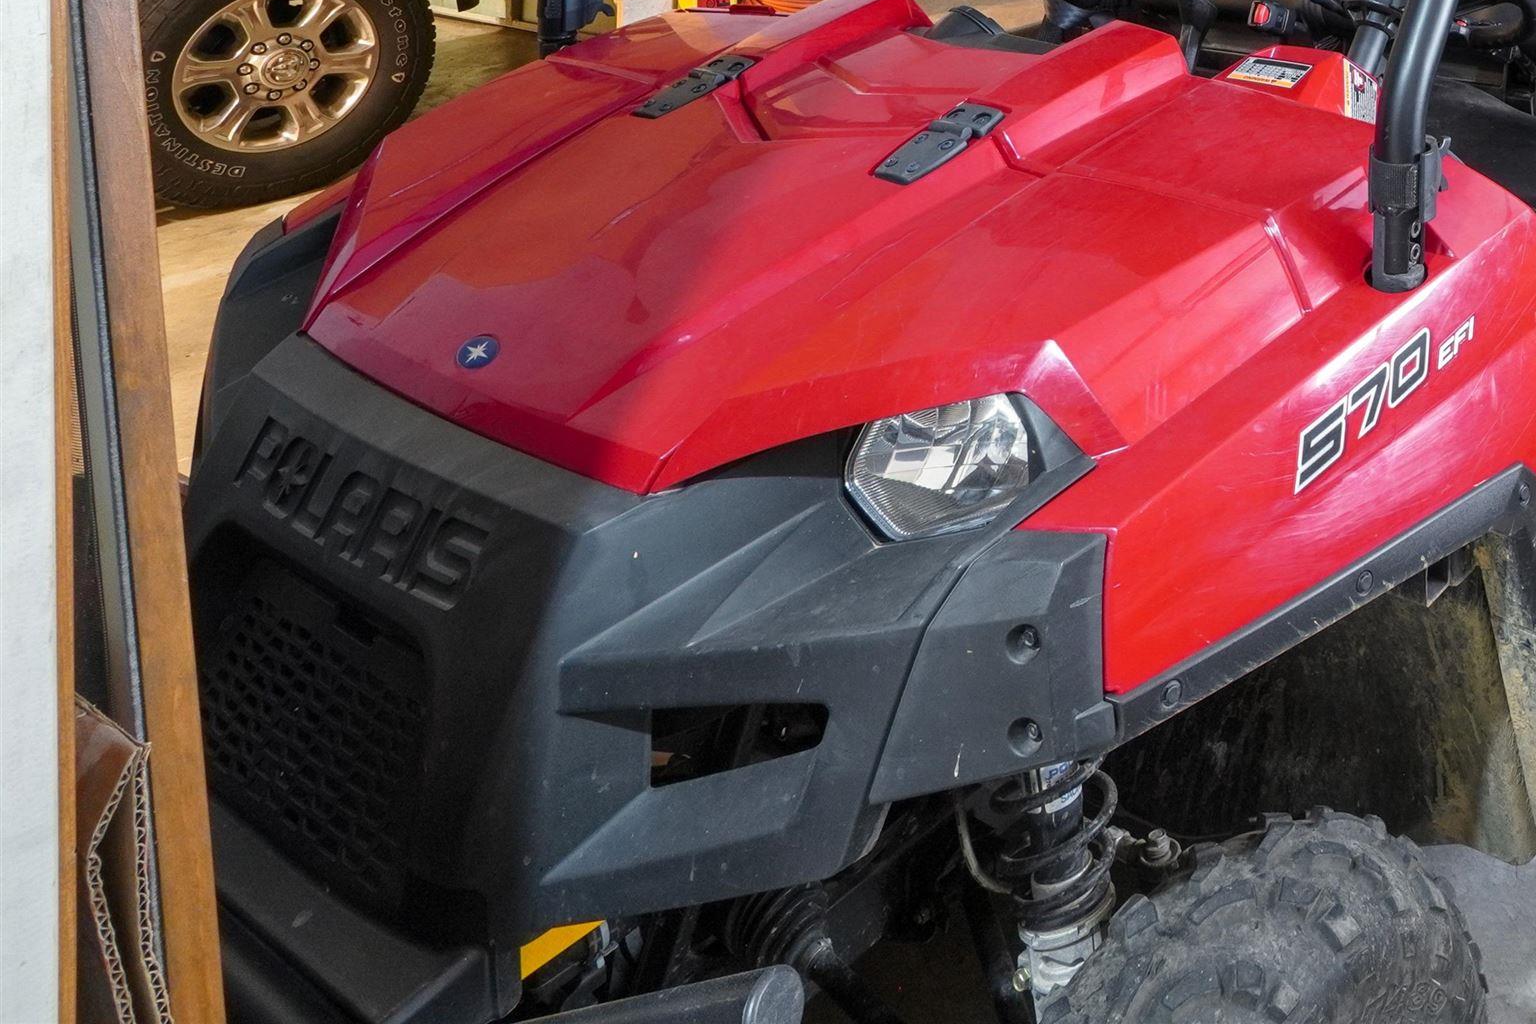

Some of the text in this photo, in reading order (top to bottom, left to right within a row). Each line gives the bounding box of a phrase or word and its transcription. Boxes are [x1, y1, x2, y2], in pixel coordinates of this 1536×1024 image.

[145, 67, 247, 178] DESTINATION
[1294, 314, 1476, 496] 570 EFI
[234, 414, 491, 612] POLARIS
